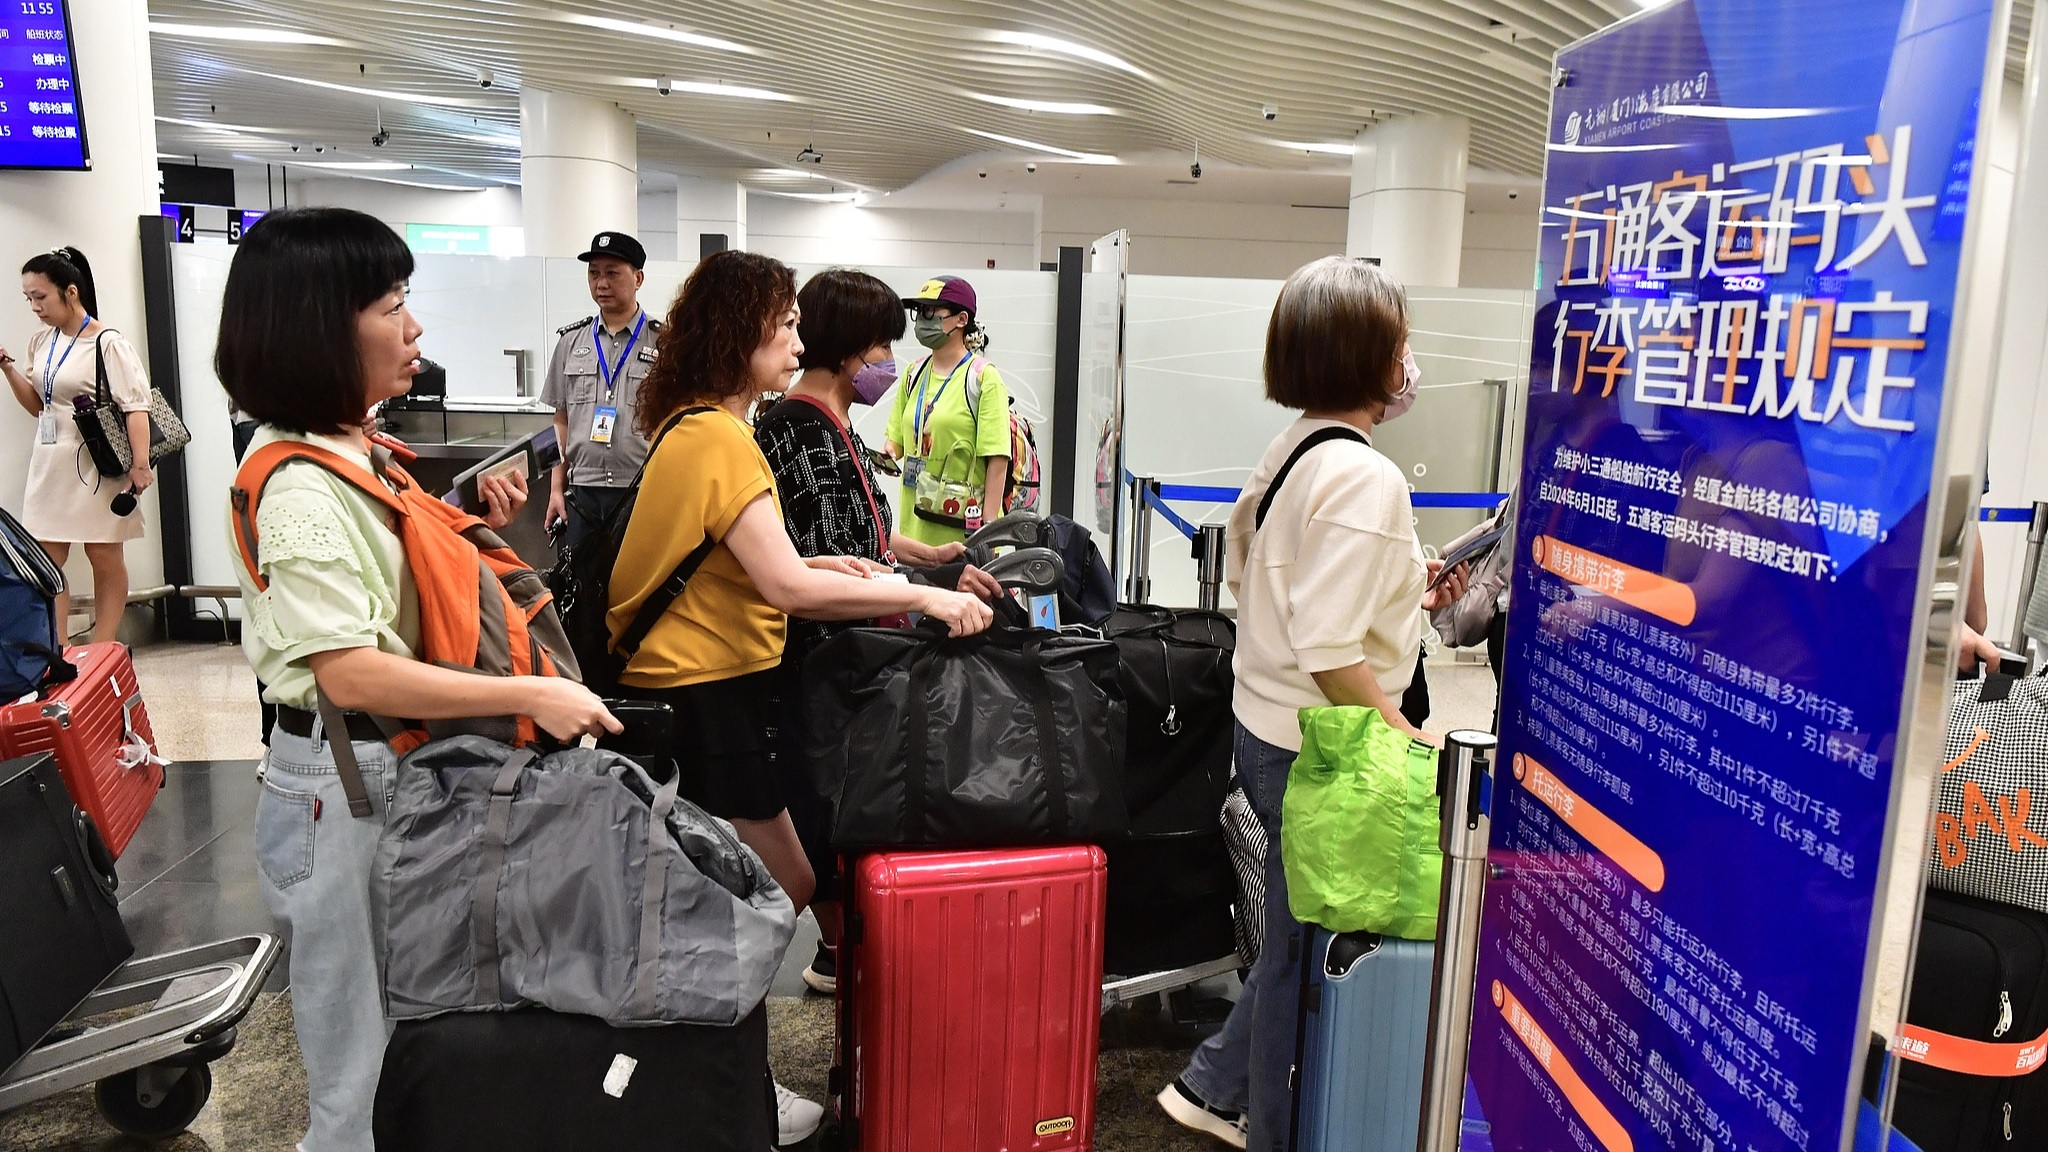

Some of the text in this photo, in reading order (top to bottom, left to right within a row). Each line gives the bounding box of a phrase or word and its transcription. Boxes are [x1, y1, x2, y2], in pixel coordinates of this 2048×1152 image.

[26, 29, 64, 40] 船班状态
[32, 53, 66, 66] 检票中
[36, 77, 70, 91] 办理中
[28, 101, 74, 115] 等待检票
[32, 125, 77, 138] 等待检票
[1557, 124, 1937, 287] 五通客运码头
[180, 218, 193, 237] 4
[230, 221, 241, 240] 5
[1551, 291, 1930, 432] 行李管理规定
[1550, 545, 1626, 594] 随身携带行李
[1532, 767, 1576, 818] 托运行李
[1510, 1003, 1553, 1069] 重要提醒
[1039, 1120, 1071, 1132] OUTDOOR
